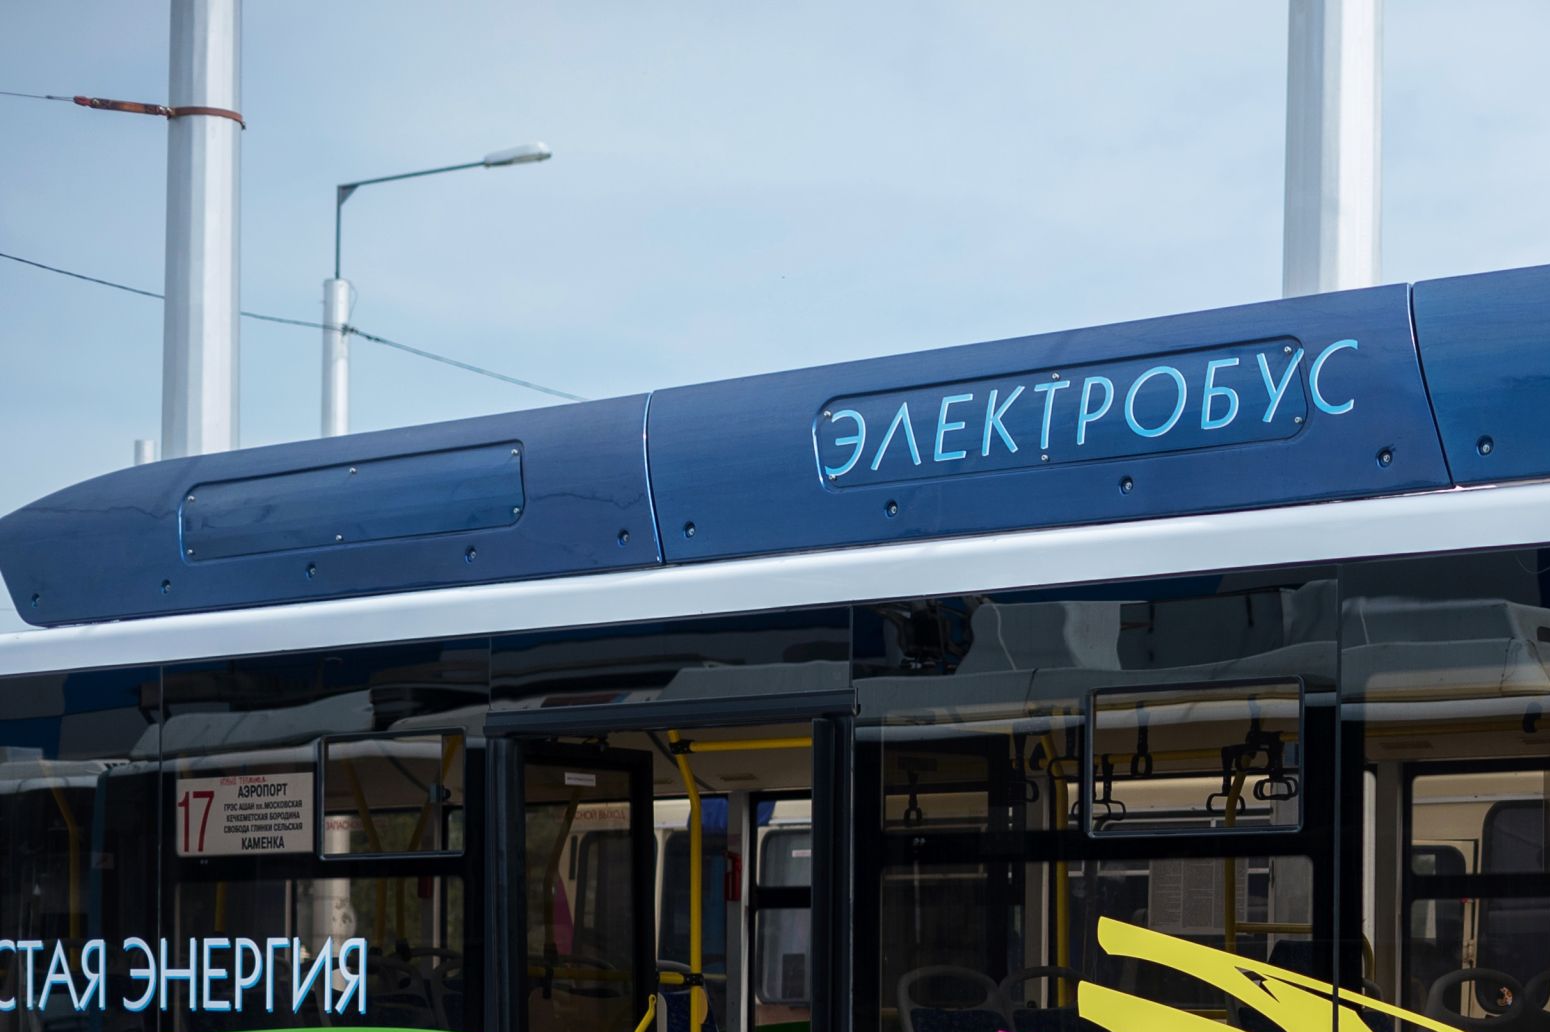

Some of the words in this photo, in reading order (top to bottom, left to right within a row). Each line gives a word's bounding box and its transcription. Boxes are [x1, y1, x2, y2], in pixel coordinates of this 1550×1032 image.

[824, 339, 1359, 477] ЭЛЕКТРОБУС
[178, 790, 215, 852] 17
[238, 783, 288, 798] АЭРОПОРТ
[241, 836, 285, 850] КАМЕНКА
[123, 936, 368, 1015] ЭНЕРГИЯ
